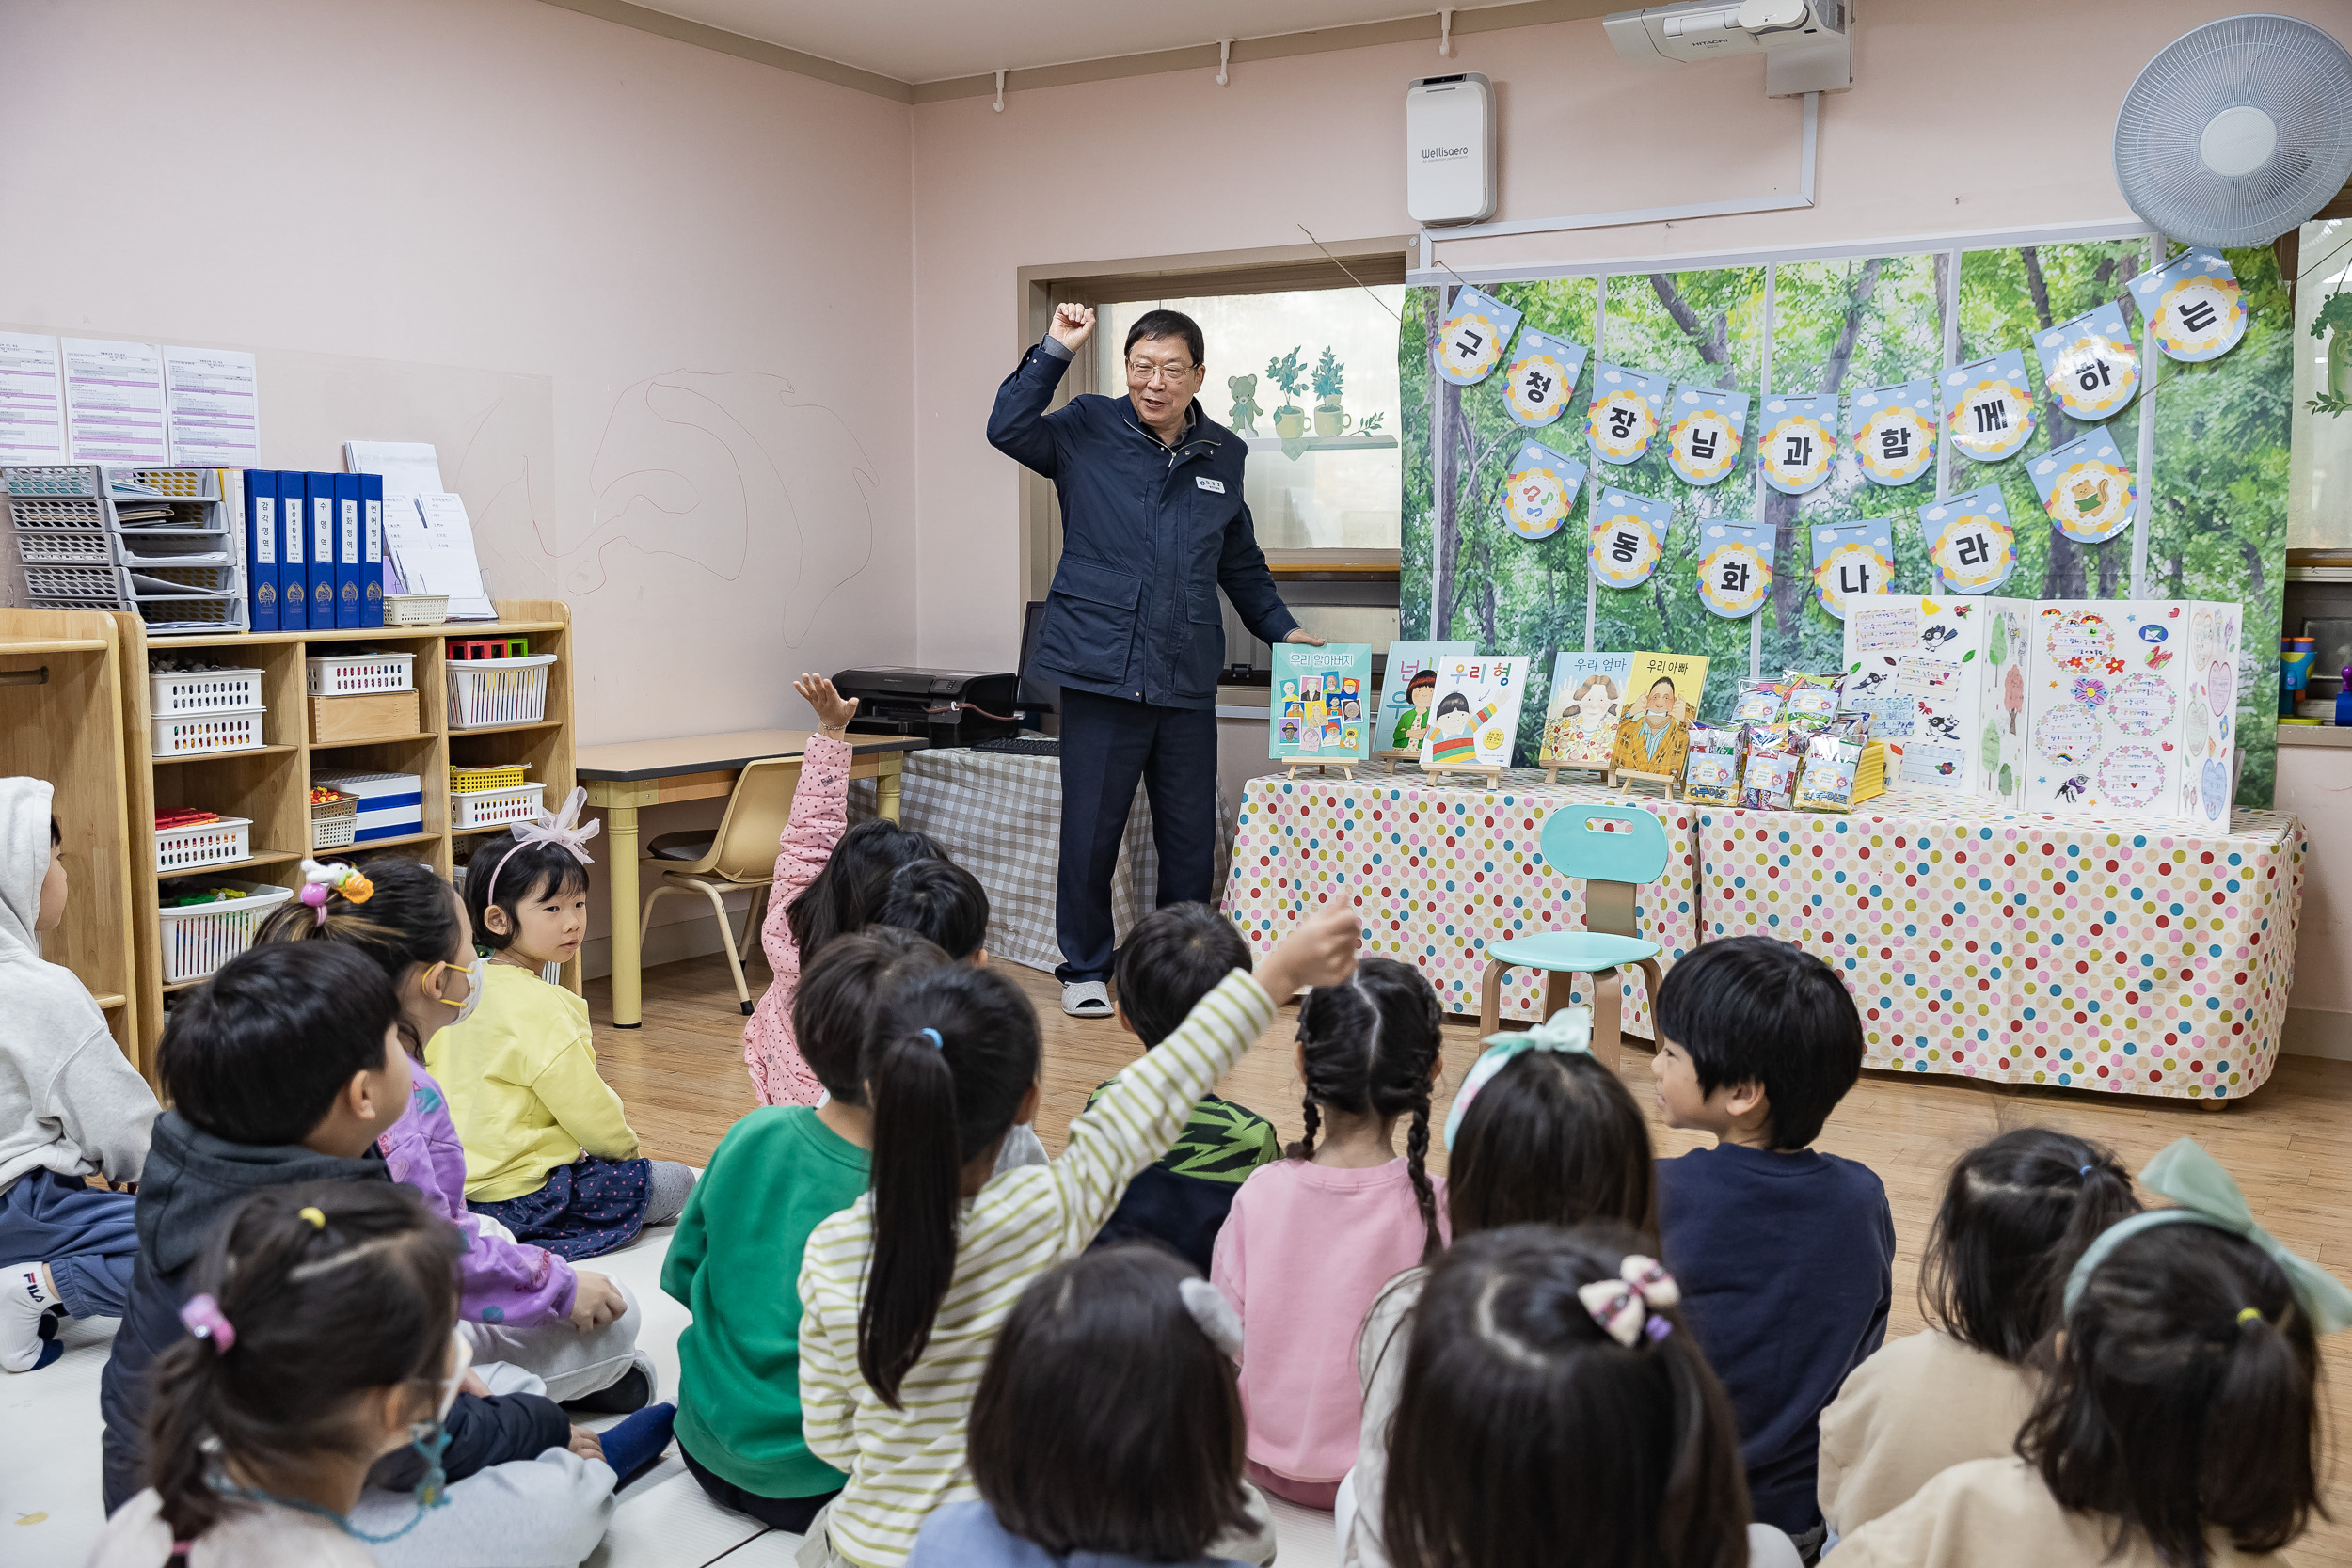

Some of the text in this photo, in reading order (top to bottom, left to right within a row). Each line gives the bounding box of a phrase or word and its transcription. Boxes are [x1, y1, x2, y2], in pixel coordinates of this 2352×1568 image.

[1692, 39, 1728, 47] HITACHI
[1422, 147, 1469, 159] Wellisaero
[262, 501, 270, 548] 감각영역
[1290, 654, 1353, 667] 우리 할아버지
[1574, 657, 1627, 672] 우리 엄마
[1647, 659, 1689, 675] 우리 아빠
[1451, 662, 1512, 687] 우리 형
[23, 1272, 46, 1303] FILA
